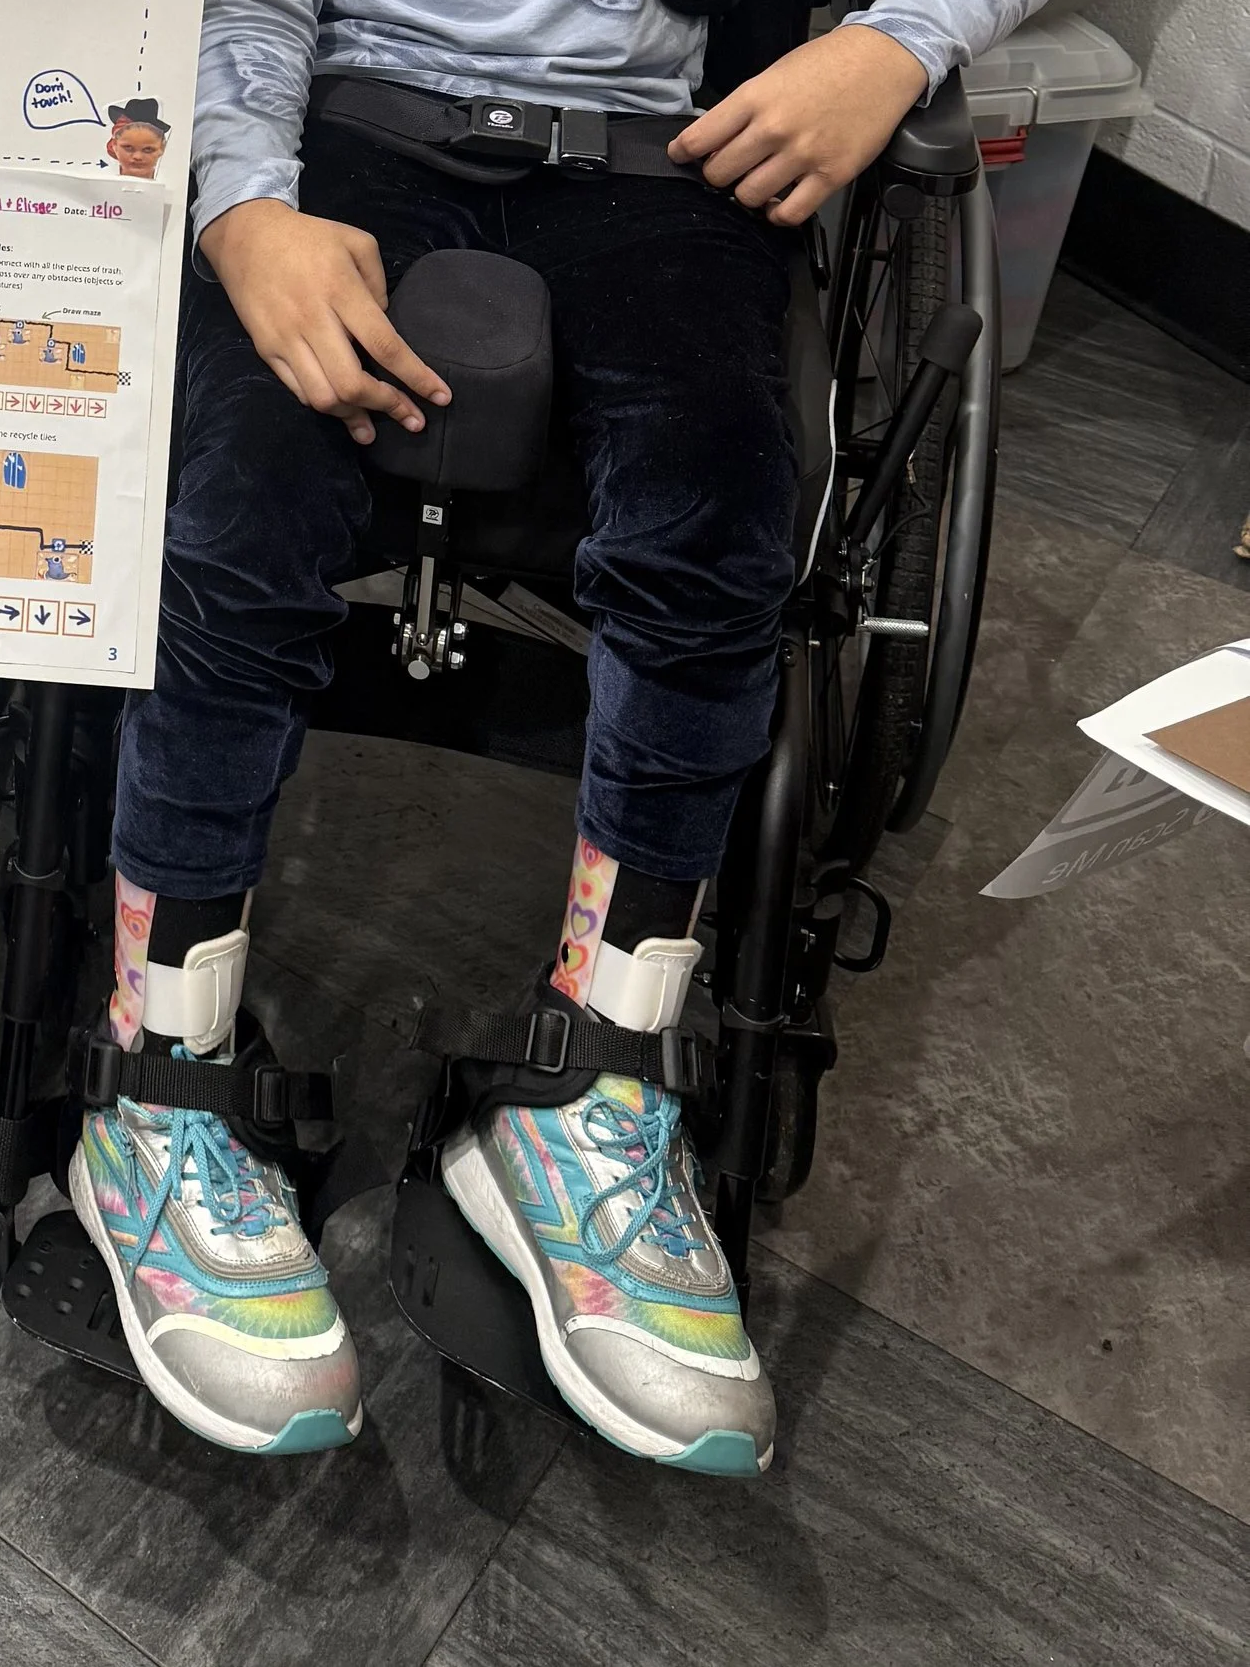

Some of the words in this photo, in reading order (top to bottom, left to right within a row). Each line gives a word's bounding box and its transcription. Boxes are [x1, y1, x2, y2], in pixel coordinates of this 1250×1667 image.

[31, 90, 73, 108] touch!
[64, 206, 88, 216] Date:
[92, 201, 122, 218] 12/10
[108, 647, 117, 661] 3
